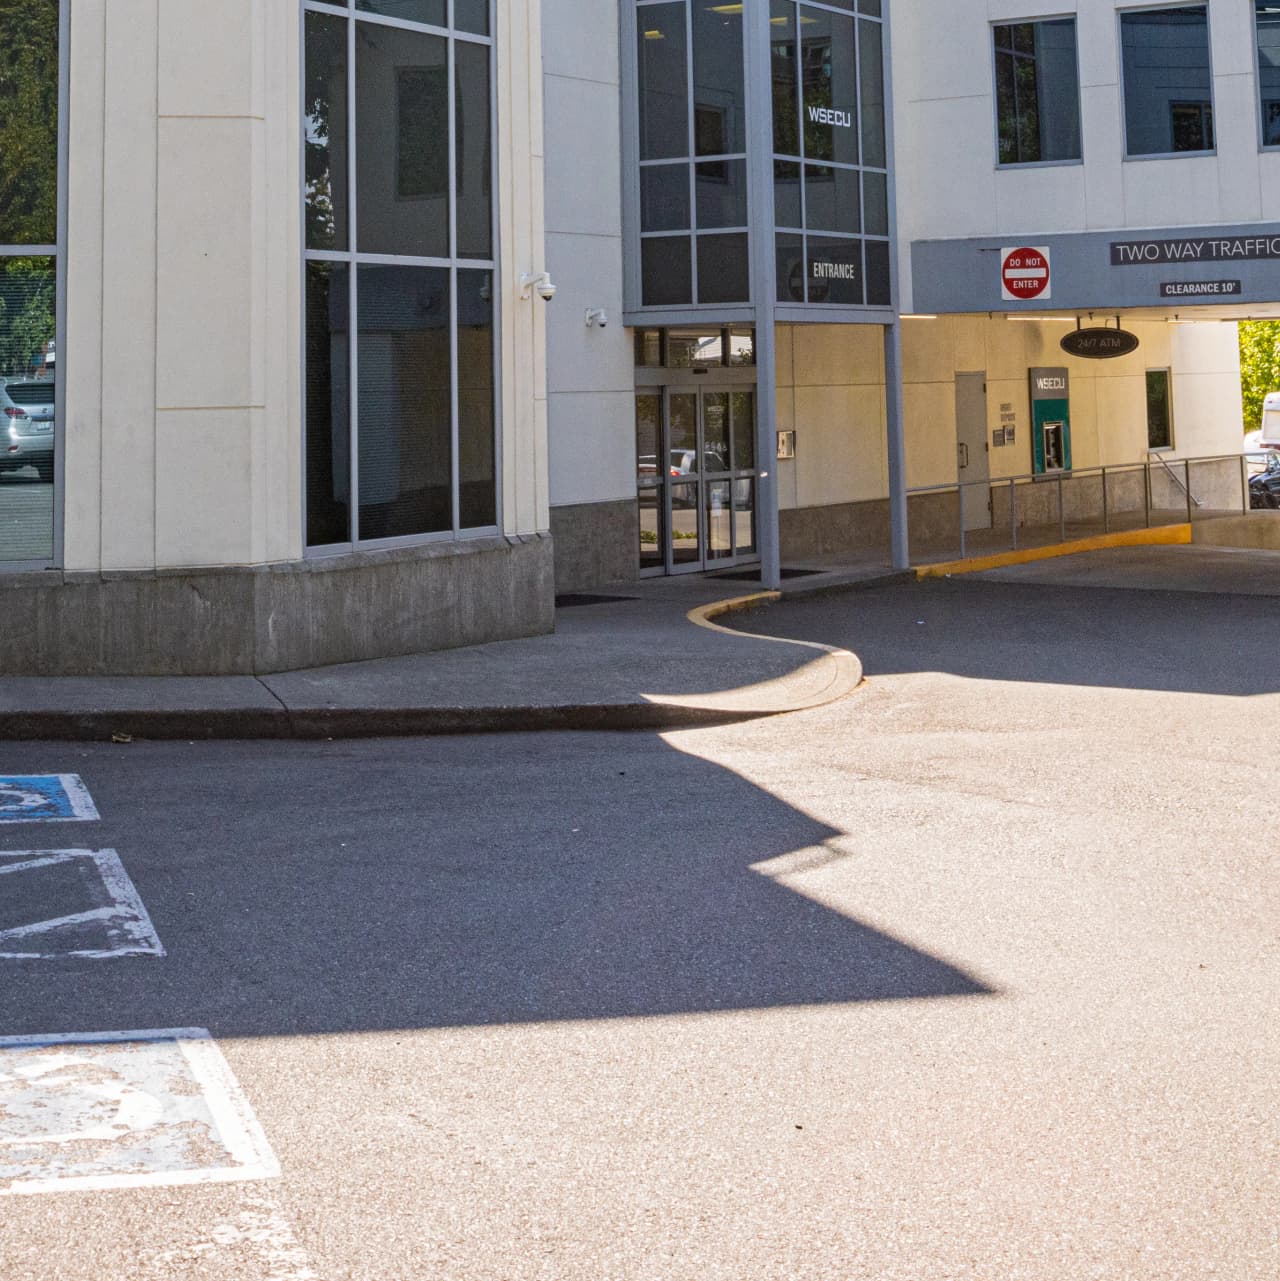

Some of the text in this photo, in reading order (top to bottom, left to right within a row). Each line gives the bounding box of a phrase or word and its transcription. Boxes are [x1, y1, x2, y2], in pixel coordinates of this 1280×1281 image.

[808, 106, 851, 128] WSECU
[1116, 243, 1159, 261] TWO
[1165, 241, 1205, 260] WAY
[1010, 257, 1041, 267] DO NOT
[813, 262, 855, 279] ENTRANCE
[1013, 280, 1039, 288] ENTER
[1165, 282, 1236, 294] CLEARANCE 10'
[1036, 377, 1065, 389] WSECU
